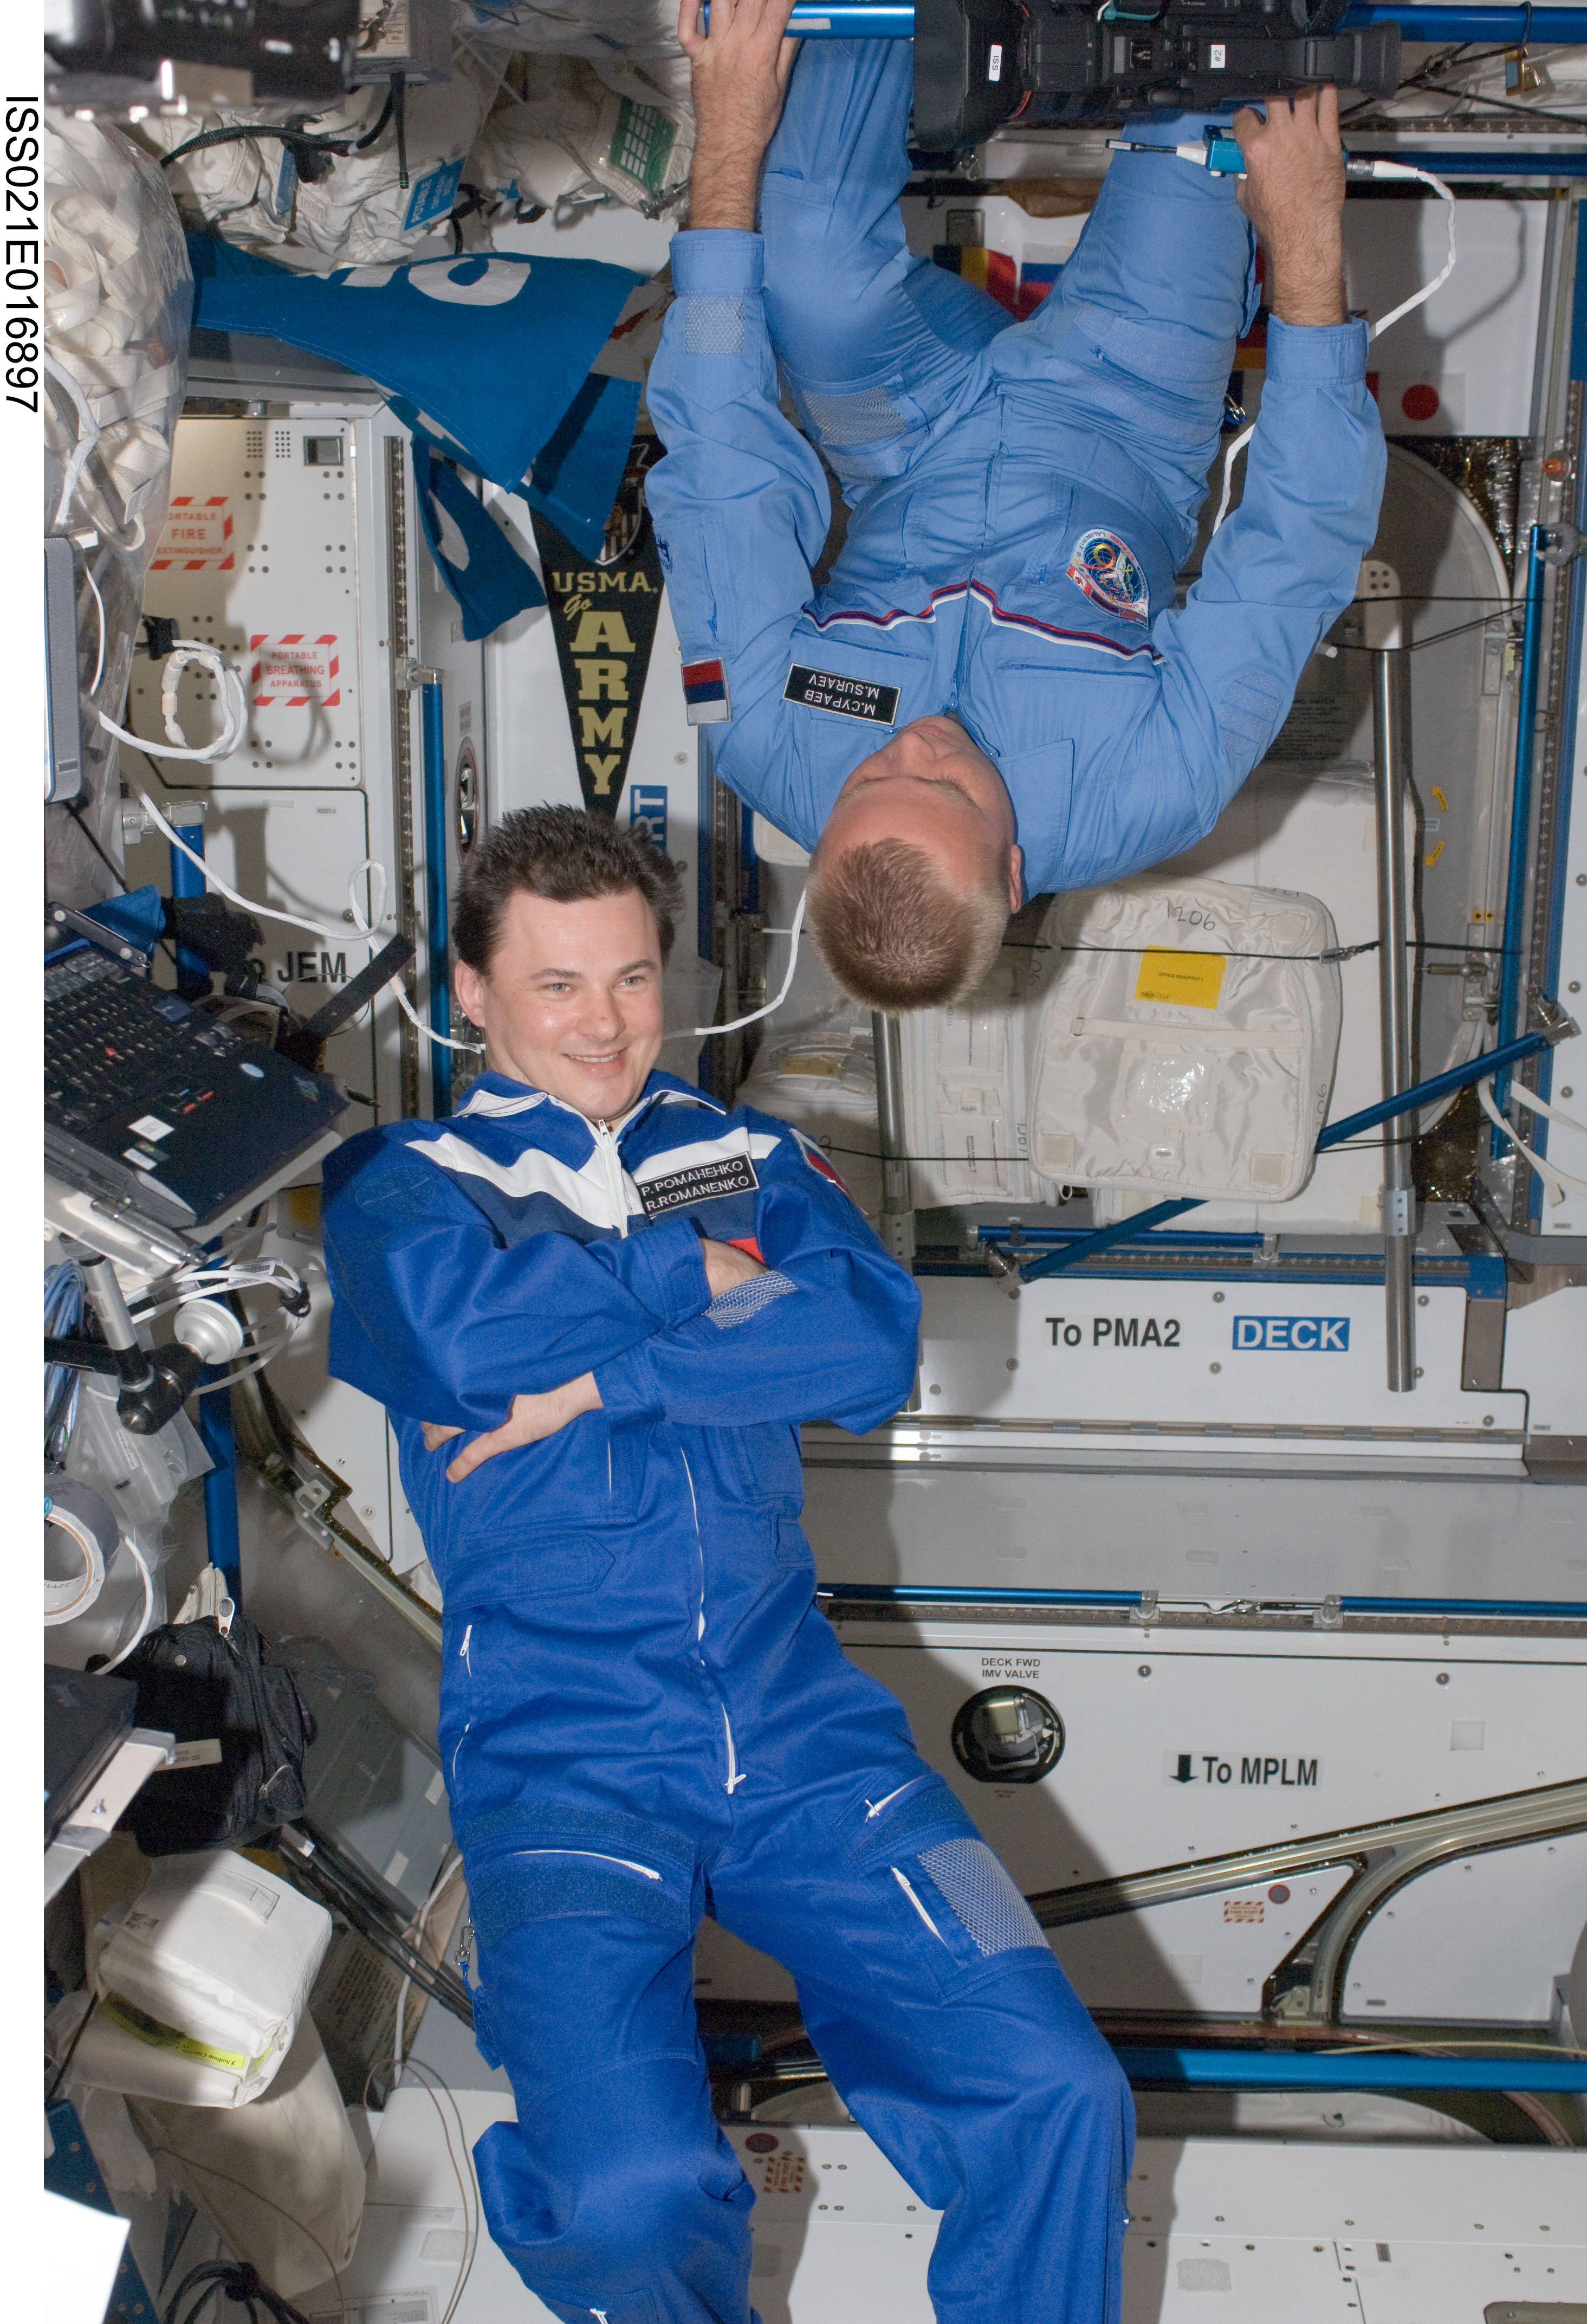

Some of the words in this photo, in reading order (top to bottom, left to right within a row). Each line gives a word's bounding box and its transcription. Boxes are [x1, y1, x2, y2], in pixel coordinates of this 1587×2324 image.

[1214, 50, 1222, 62] #2
[412, 180, 431, 223] POTABLE
[172, 529, 206, 539] FIRE
[563, 594, 592, 621] Go
[272, 651, 318, 660] PORTABLE
[267, 666, 325, 675] BREATHING
[270, 680, 322, 688] APPARATUS
[809, 674, 879, 699] M.SURAEV
[570, 611, 636, 795] ARMY
[805, 690, 877, 715] М.СУРАЕВ
[1168, 900, 1216, 931] 1206
[277, 952, 346, 983] JEM
[655, 1161, 743, 1192] РОМАНЕНКО
[646, 1176, 749, 1211] R.ROMANENKO
[1046, 1318, 1081, 1346] To
[1093, 1319, 1181, 1347] PMA2
[1238, 1320, 1346, 1350] DECK
[982, 1658, 1013, 1666] DECK
[1016, 1658, 1041, 1667] FWD
[982, 1669, 1001, 1677] IMV
[1005, 1670, 1039, 1679] VALVE
[1203, 1757, 1232, 1784] To
[1241, 1758, 1318, 1786] MPLM
[209, 2055, 230, 2065] Sodium
